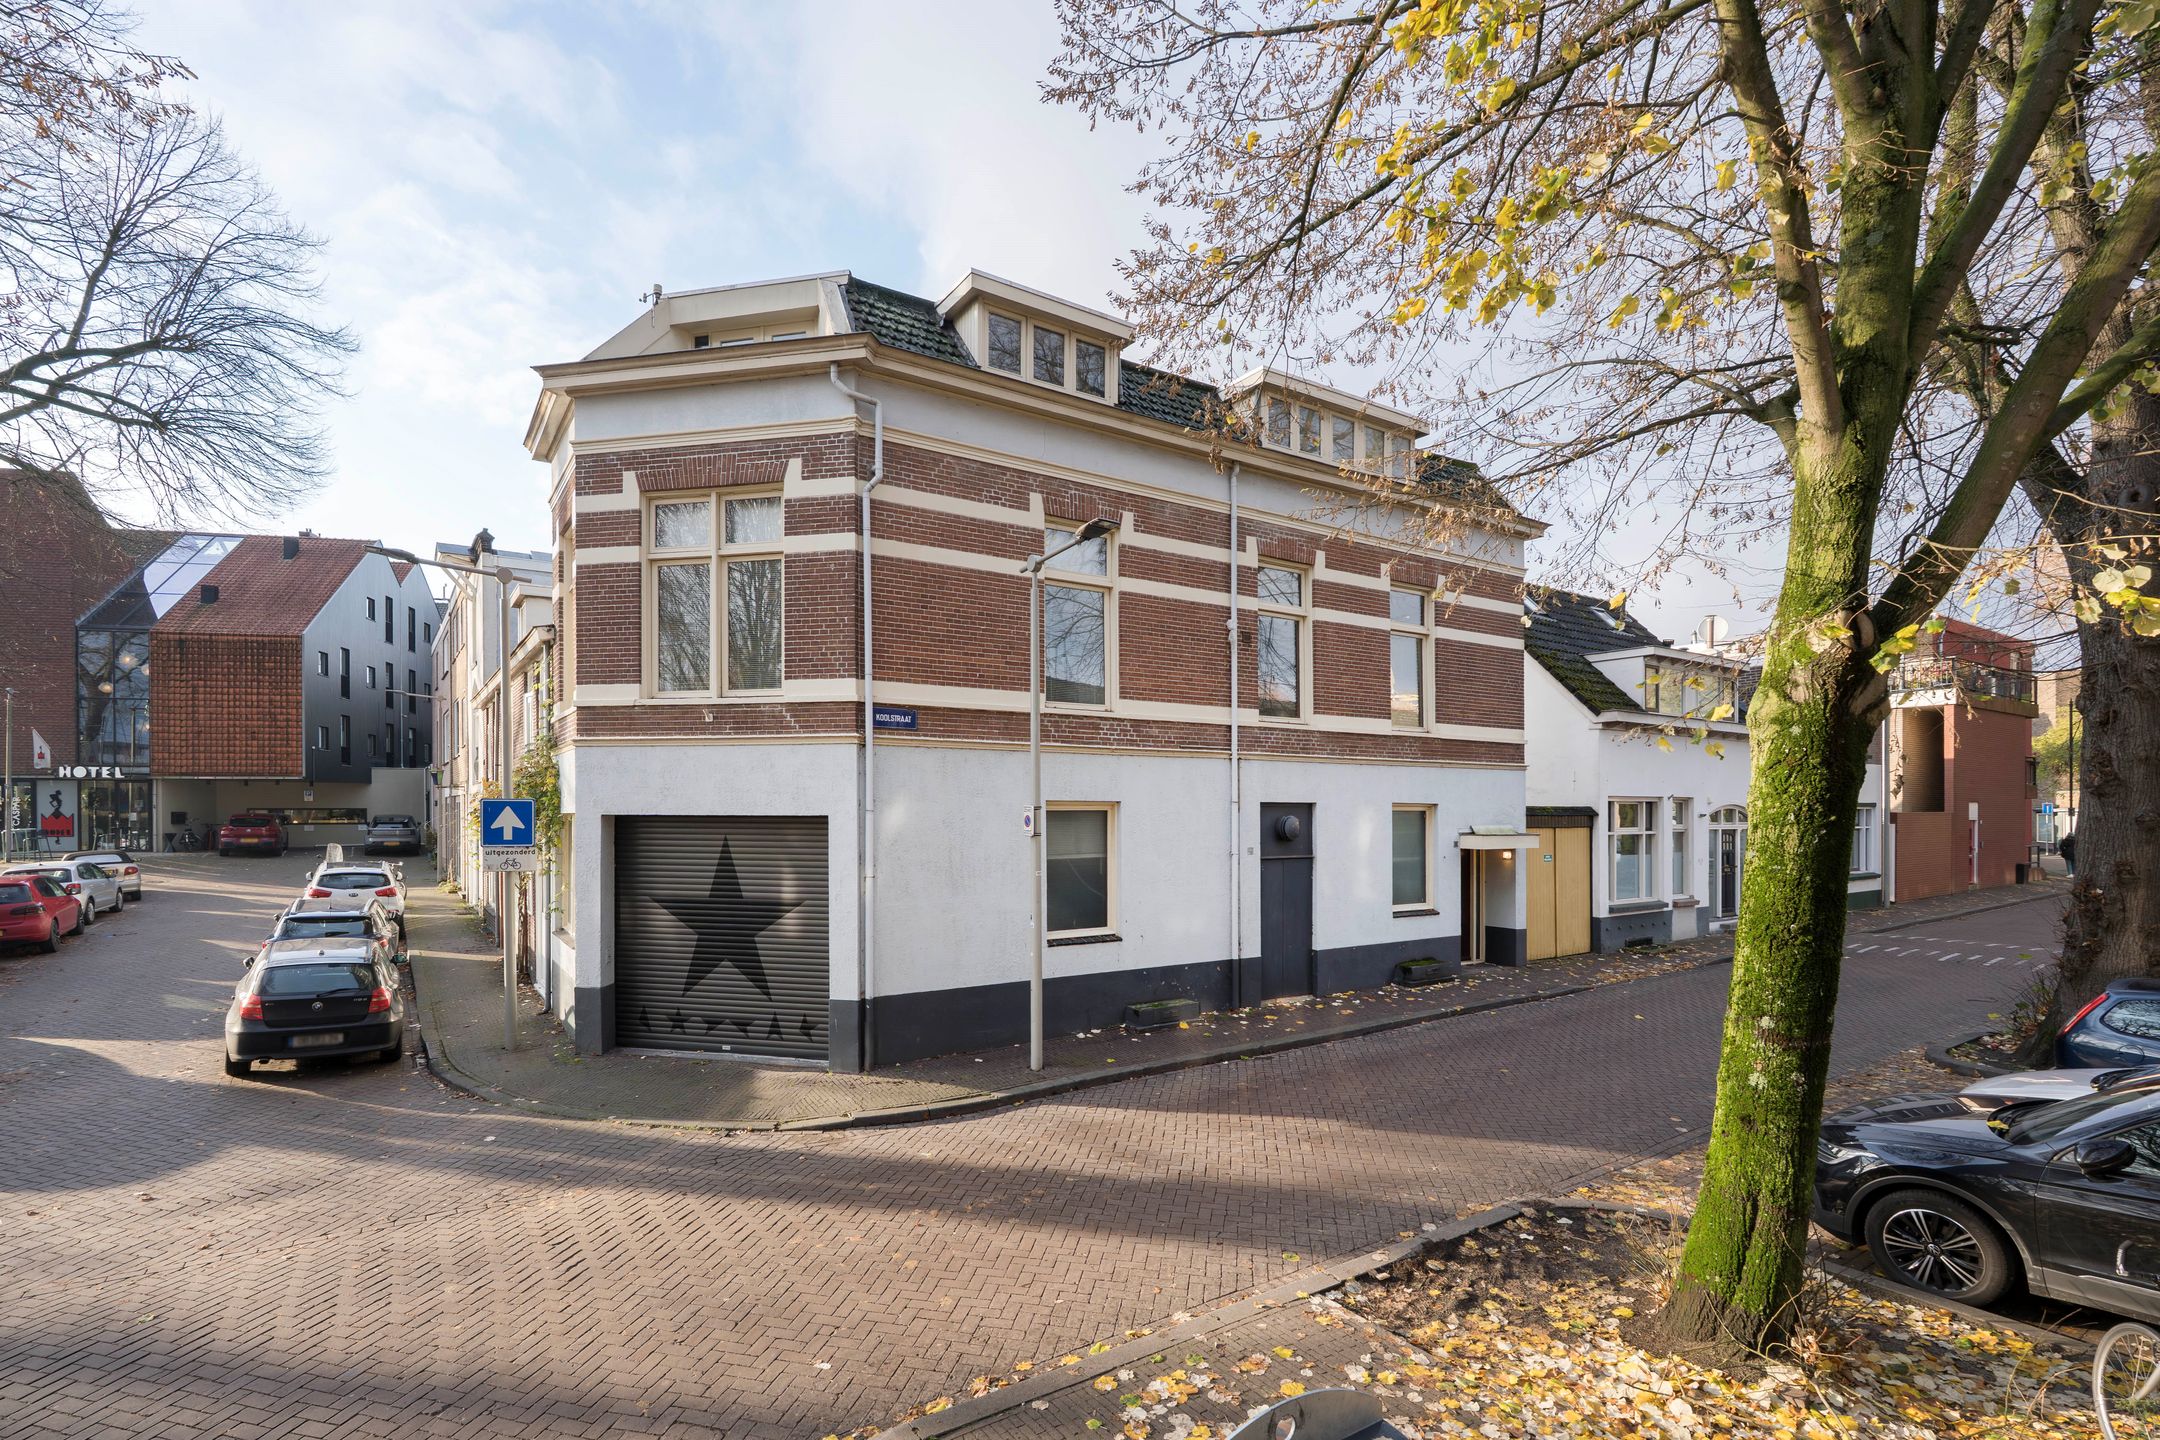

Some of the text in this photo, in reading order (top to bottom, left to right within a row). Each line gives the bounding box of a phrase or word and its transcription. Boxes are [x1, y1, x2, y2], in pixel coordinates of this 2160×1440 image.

[875, 714, 912, 723] KOOLSTRAAT
[58, 766, 125, 779] HOTEL
[12, 797, 21, 826] CASPAR
